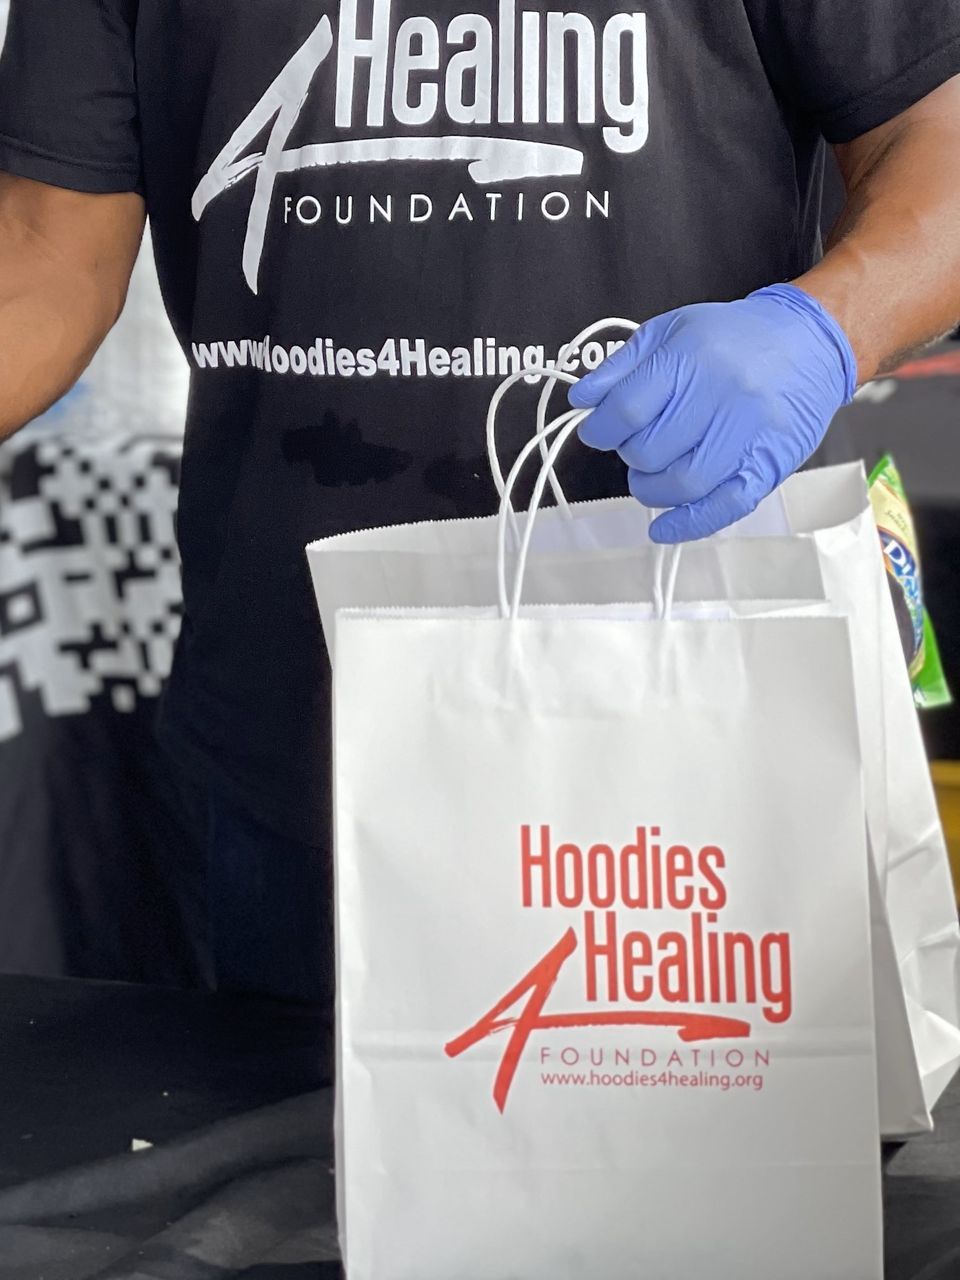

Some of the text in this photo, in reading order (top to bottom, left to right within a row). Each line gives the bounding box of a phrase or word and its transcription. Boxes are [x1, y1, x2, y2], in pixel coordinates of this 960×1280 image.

[192, 14, 584, 295] 4
[283, 190, 610, 224] FOUNDATION
[519, 824, 728, 910] Hoodies
[443, 910, 793, 1115] 4 Healing
[541, 1046, 771, 1067] FOUNDATION
[541, 1071, 764, 1091] www.hoodies4healing.org
